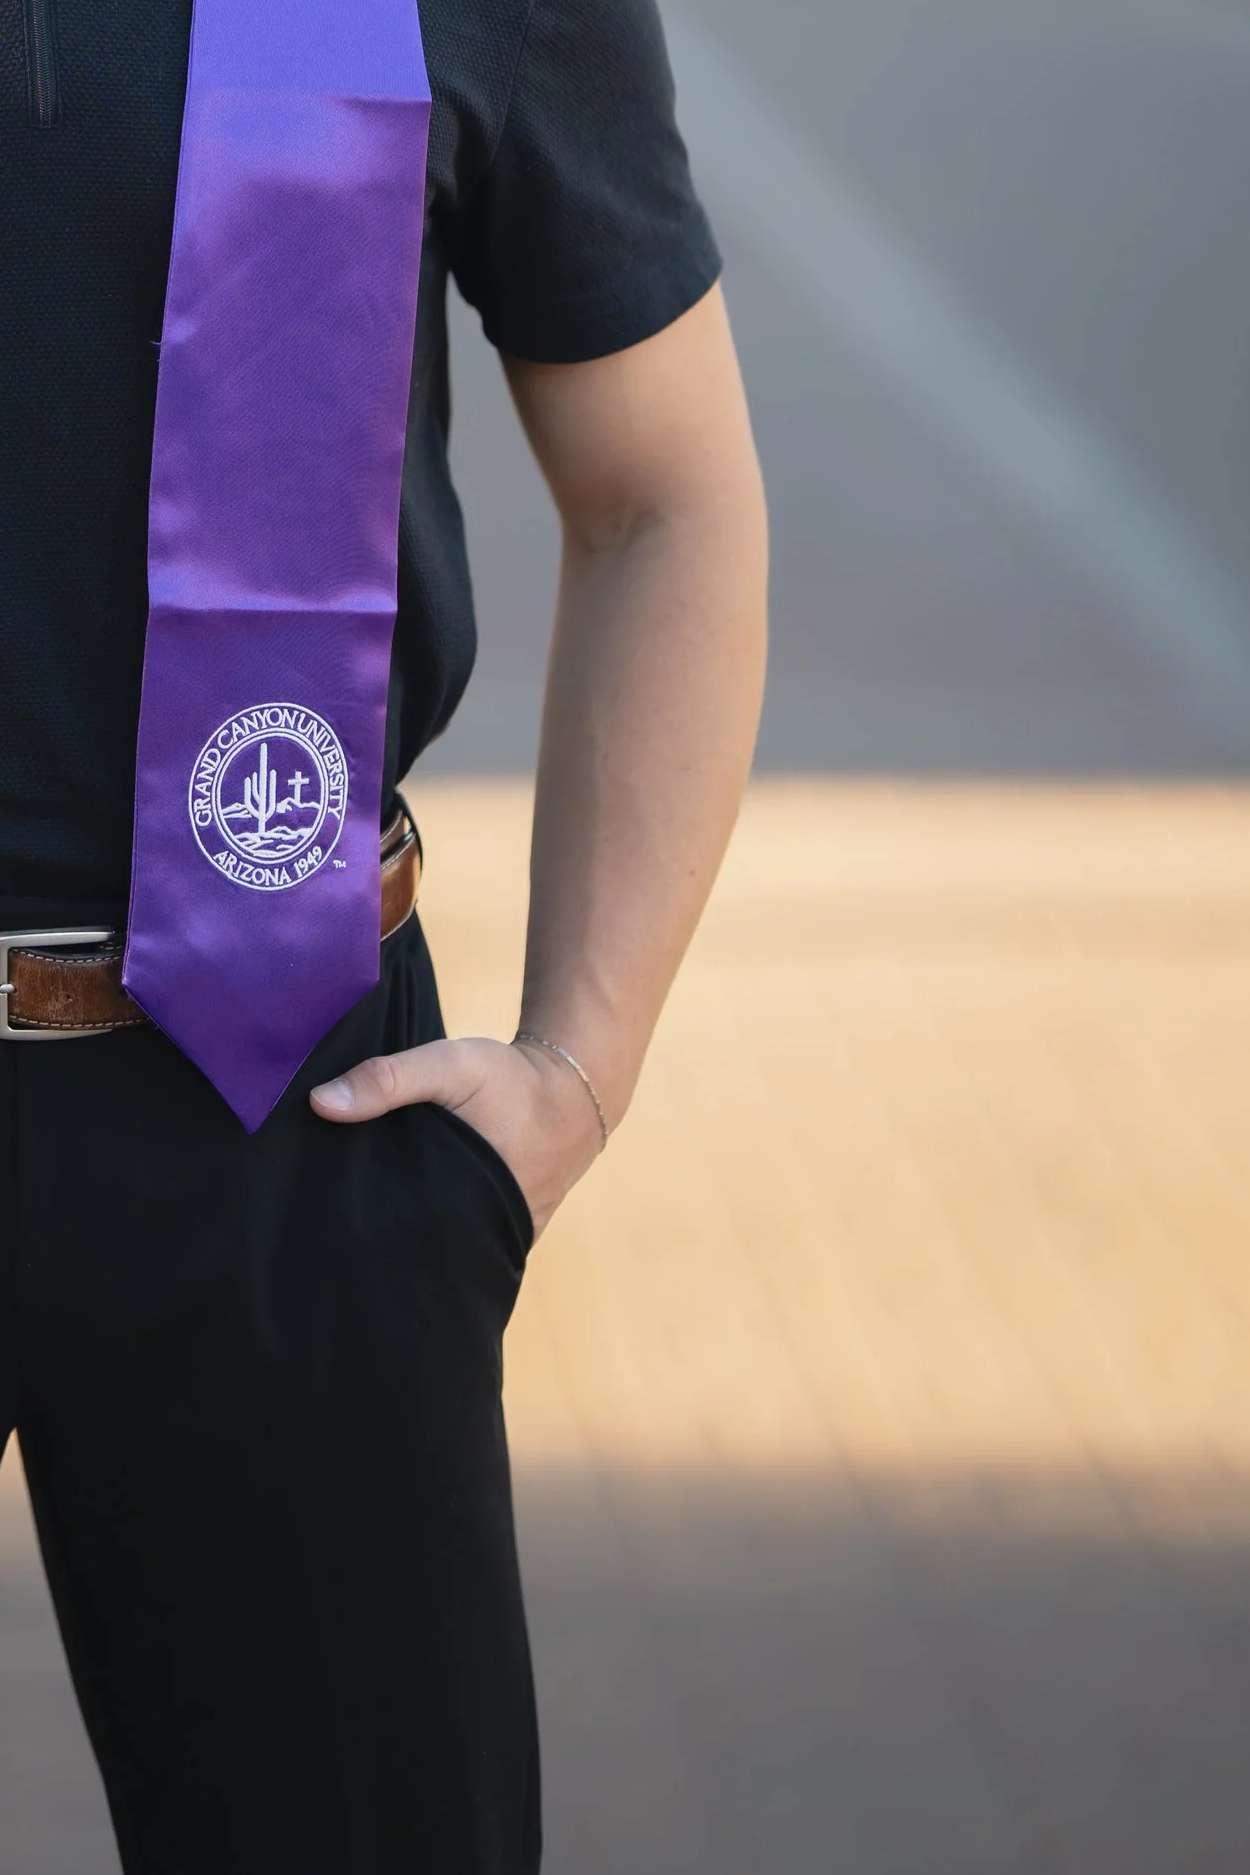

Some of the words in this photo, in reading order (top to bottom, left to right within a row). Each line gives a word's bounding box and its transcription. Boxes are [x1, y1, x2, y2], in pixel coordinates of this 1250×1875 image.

[193, 748, 222, 827] GRAND
[217, 707, 298, 750] CANYON
[296, 712, 346, 821] UNIVERSITY
[213, 850, 292, 886] ARIZONA
[293, 845, 324, 878] 1949
